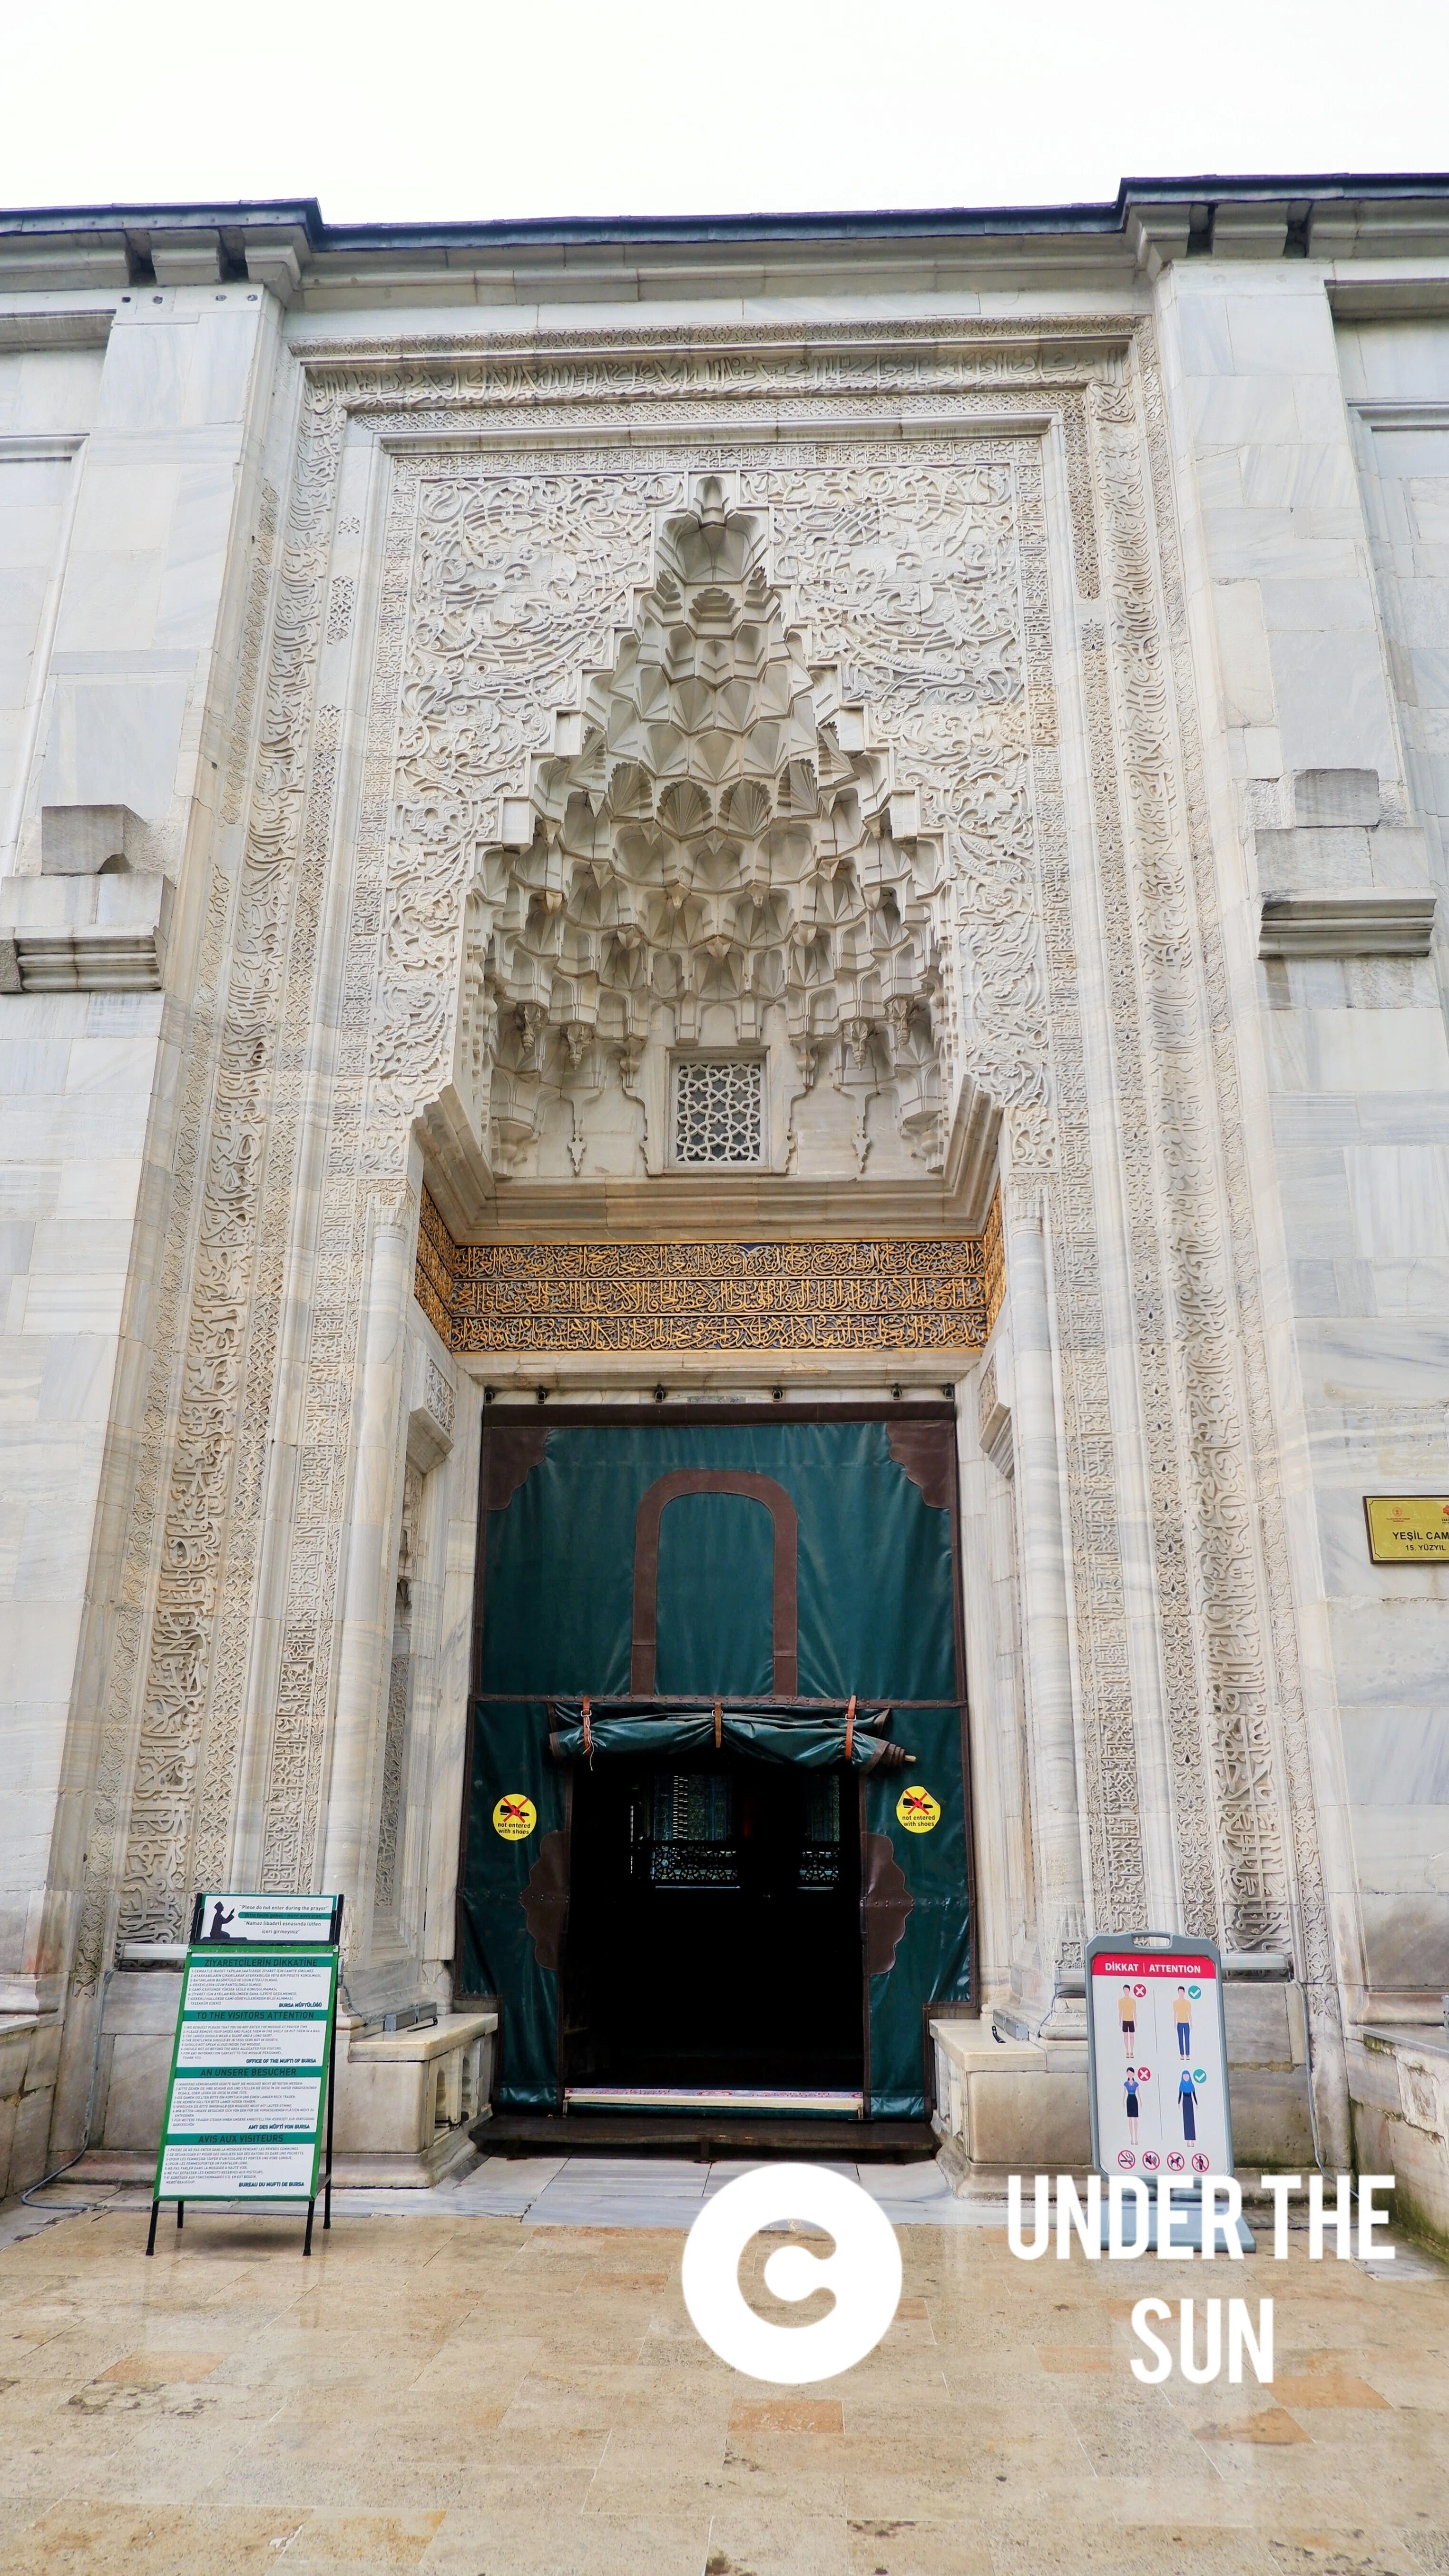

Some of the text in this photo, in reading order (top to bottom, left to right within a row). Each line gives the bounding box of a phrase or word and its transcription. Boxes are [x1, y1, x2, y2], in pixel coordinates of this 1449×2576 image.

[1392, 1530, 1422, 1541] YEŞİL
[274, 1957, 317, 1966] DİKKATİNE
[1105, 1961, 1201, 1974] DİKKAT ATTENTION
[252, 2068, 296, 2076] BESUCHER
[240, 2135, 284, 2143] VISITEURS
